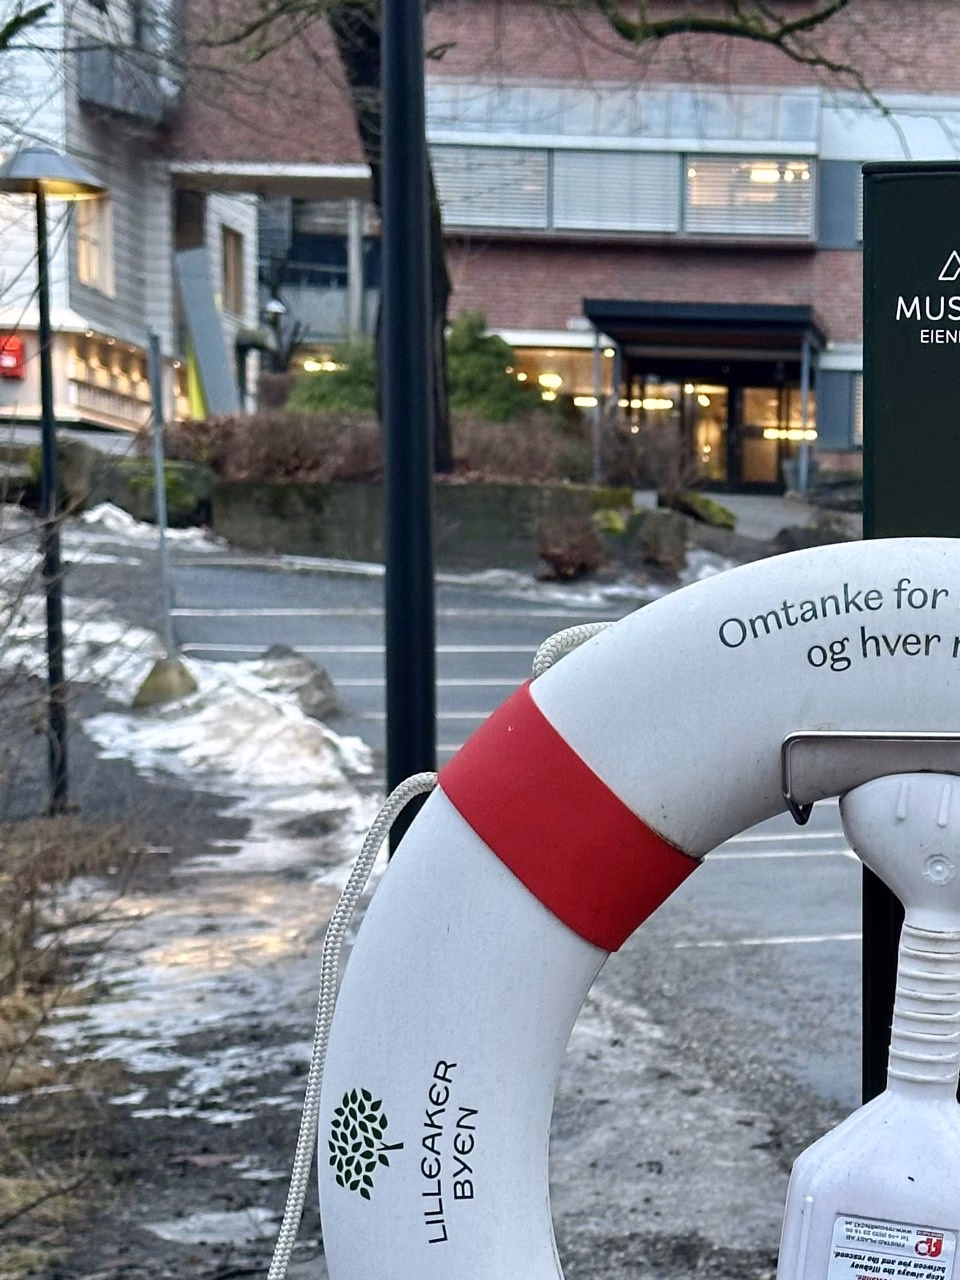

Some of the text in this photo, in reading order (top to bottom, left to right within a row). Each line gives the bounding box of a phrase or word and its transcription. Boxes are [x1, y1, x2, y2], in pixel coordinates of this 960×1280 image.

[718, 583, 884, 649] Omtanke
[894, 578, 949, 610] for
[807, 635, 852, 672] og
[860, 626, 940, 659] hver
[420, 1060, 457, 1244] LILLEAKER
[453, 1107, 479, 1200] BYEN
[850, 1262, 880, 1273] lifebuoy
[897, 1269, 924, 1279] always
[914, 1263, 946, 1274] between
